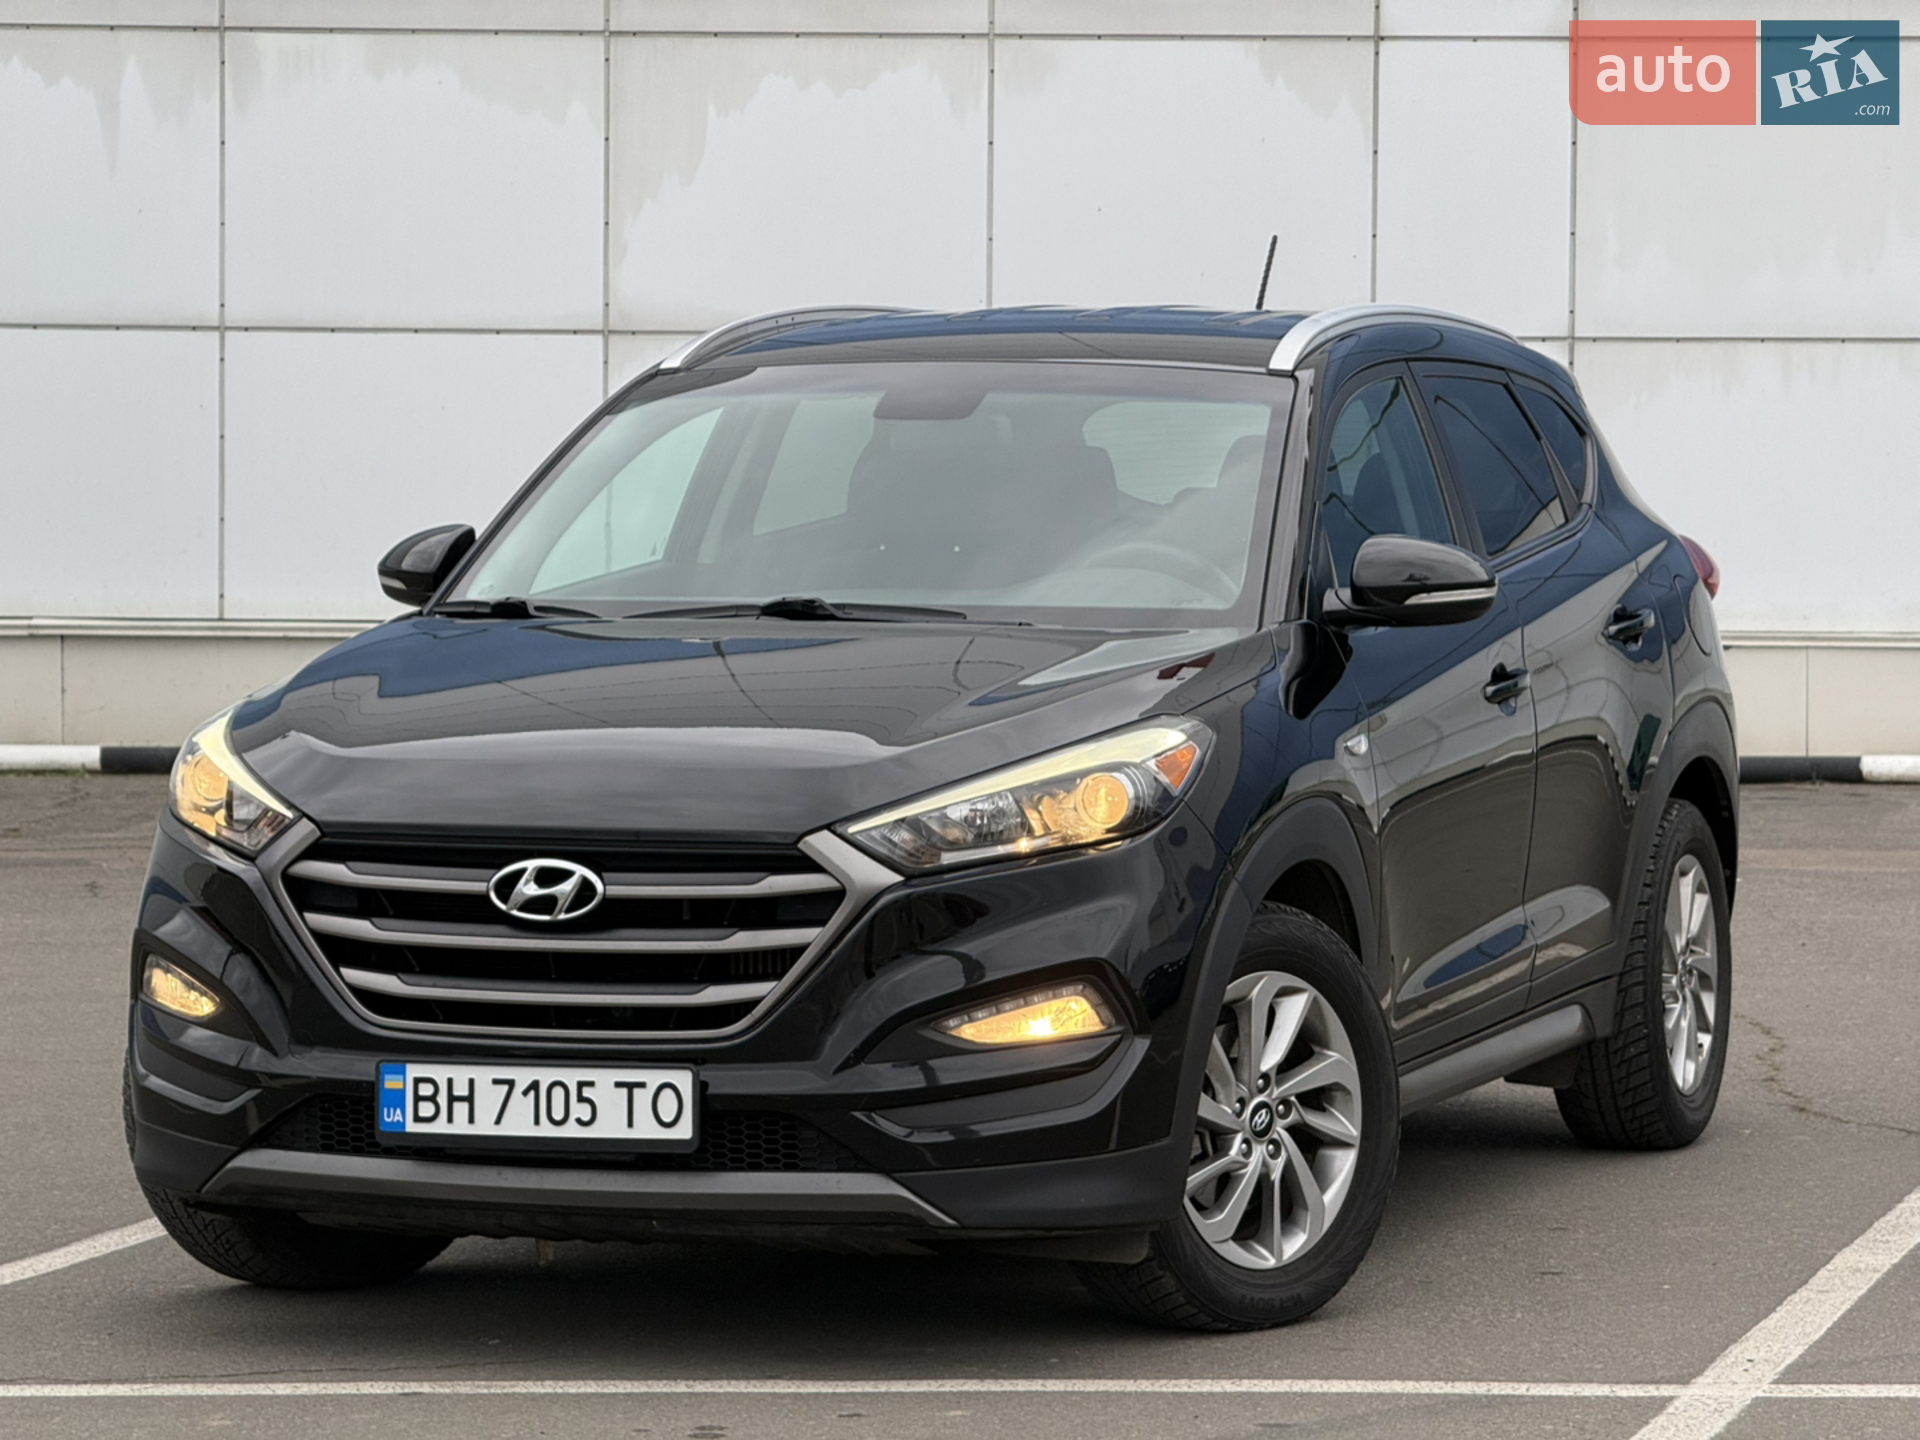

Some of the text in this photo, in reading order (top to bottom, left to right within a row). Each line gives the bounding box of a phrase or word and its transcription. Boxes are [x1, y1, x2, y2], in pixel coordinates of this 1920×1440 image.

[383, 1107, 404, 1123] UA
[412, 1076, 684, 1129] BH 7105 TO
